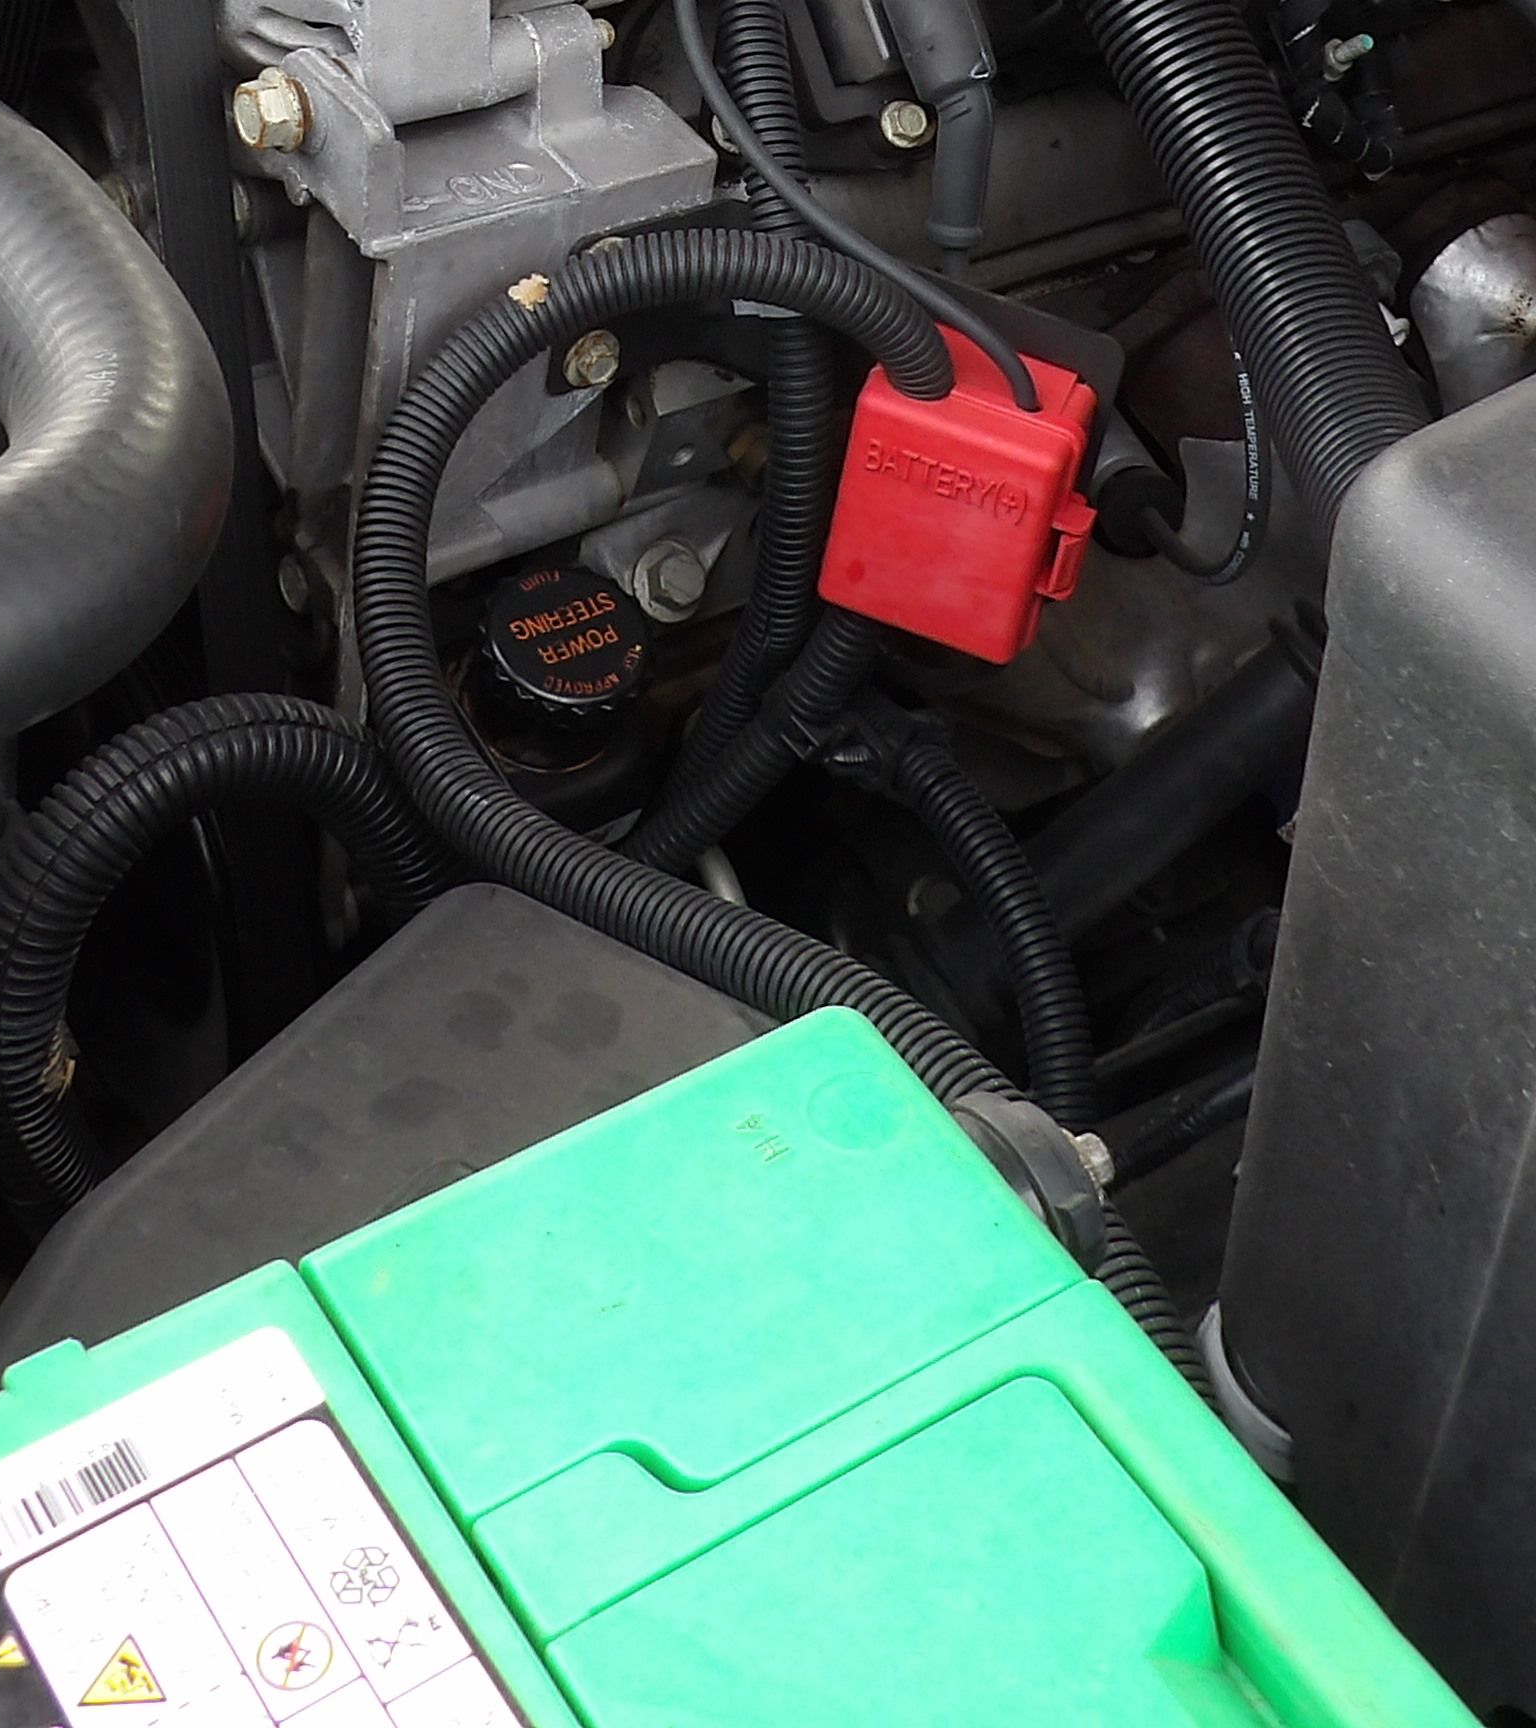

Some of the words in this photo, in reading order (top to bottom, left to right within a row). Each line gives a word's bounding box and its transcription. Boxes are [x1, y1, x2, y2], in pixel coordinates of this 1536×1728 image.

[447, 160, 545, 206] GND
[1237, 373, 1252, 405] HIGH
[1245, 409, 1259, 501] TEMPERATURE
[864, 437, 1028, 526] BATTERY(+)
[509, 592, 616, 641] STEERING
[537, 624, 619, 665] POWER
[543, 673, 621, 696] APPROVED
